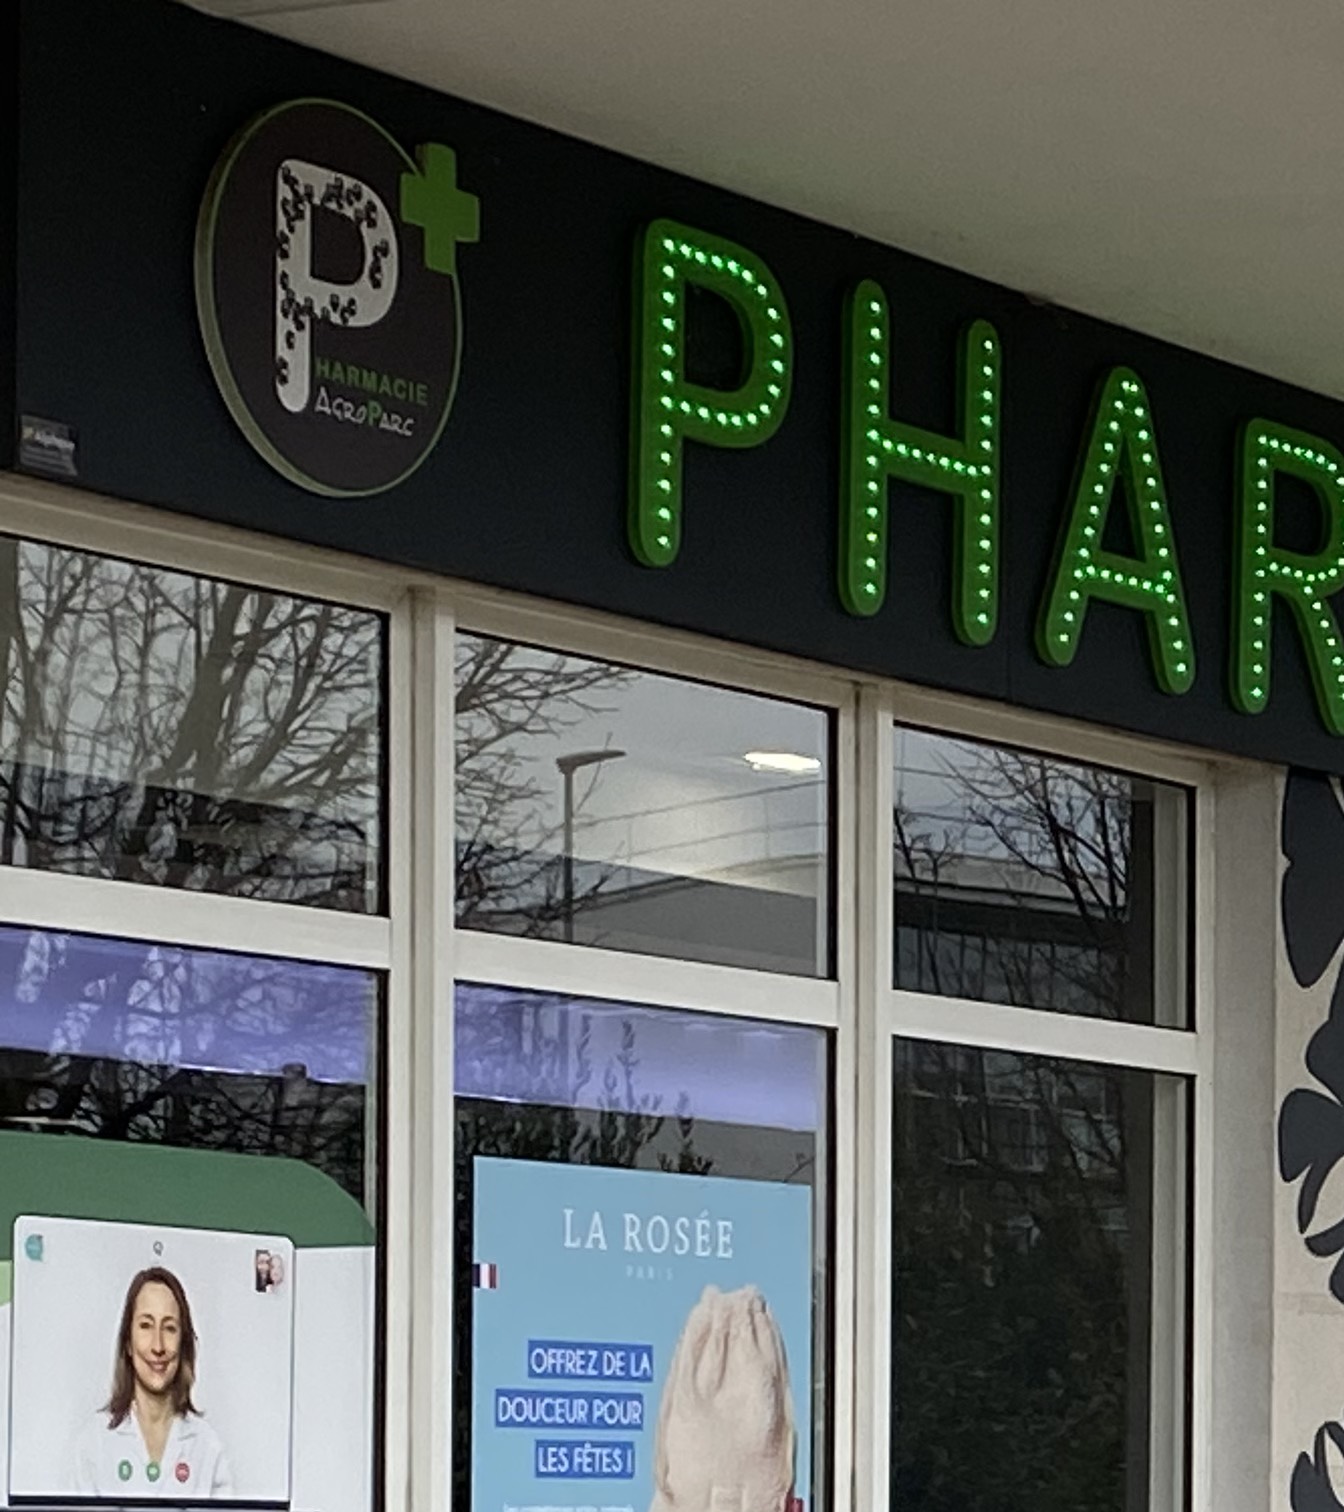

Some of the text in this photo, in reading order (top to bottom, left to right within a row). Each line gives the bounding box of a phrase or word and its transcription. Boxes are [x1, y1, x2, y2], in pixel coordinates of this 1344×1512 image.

[563, 1208, 733, 1259] LA ROSÉE
[530, 1347, 653, 1378] OFFREZ DE LA
[499, 1396, 643, 1425] DOUCEUR POUR
[538, 1447, 569, 1473] LES
[573, 1441, 624, 1474] FÊTES
